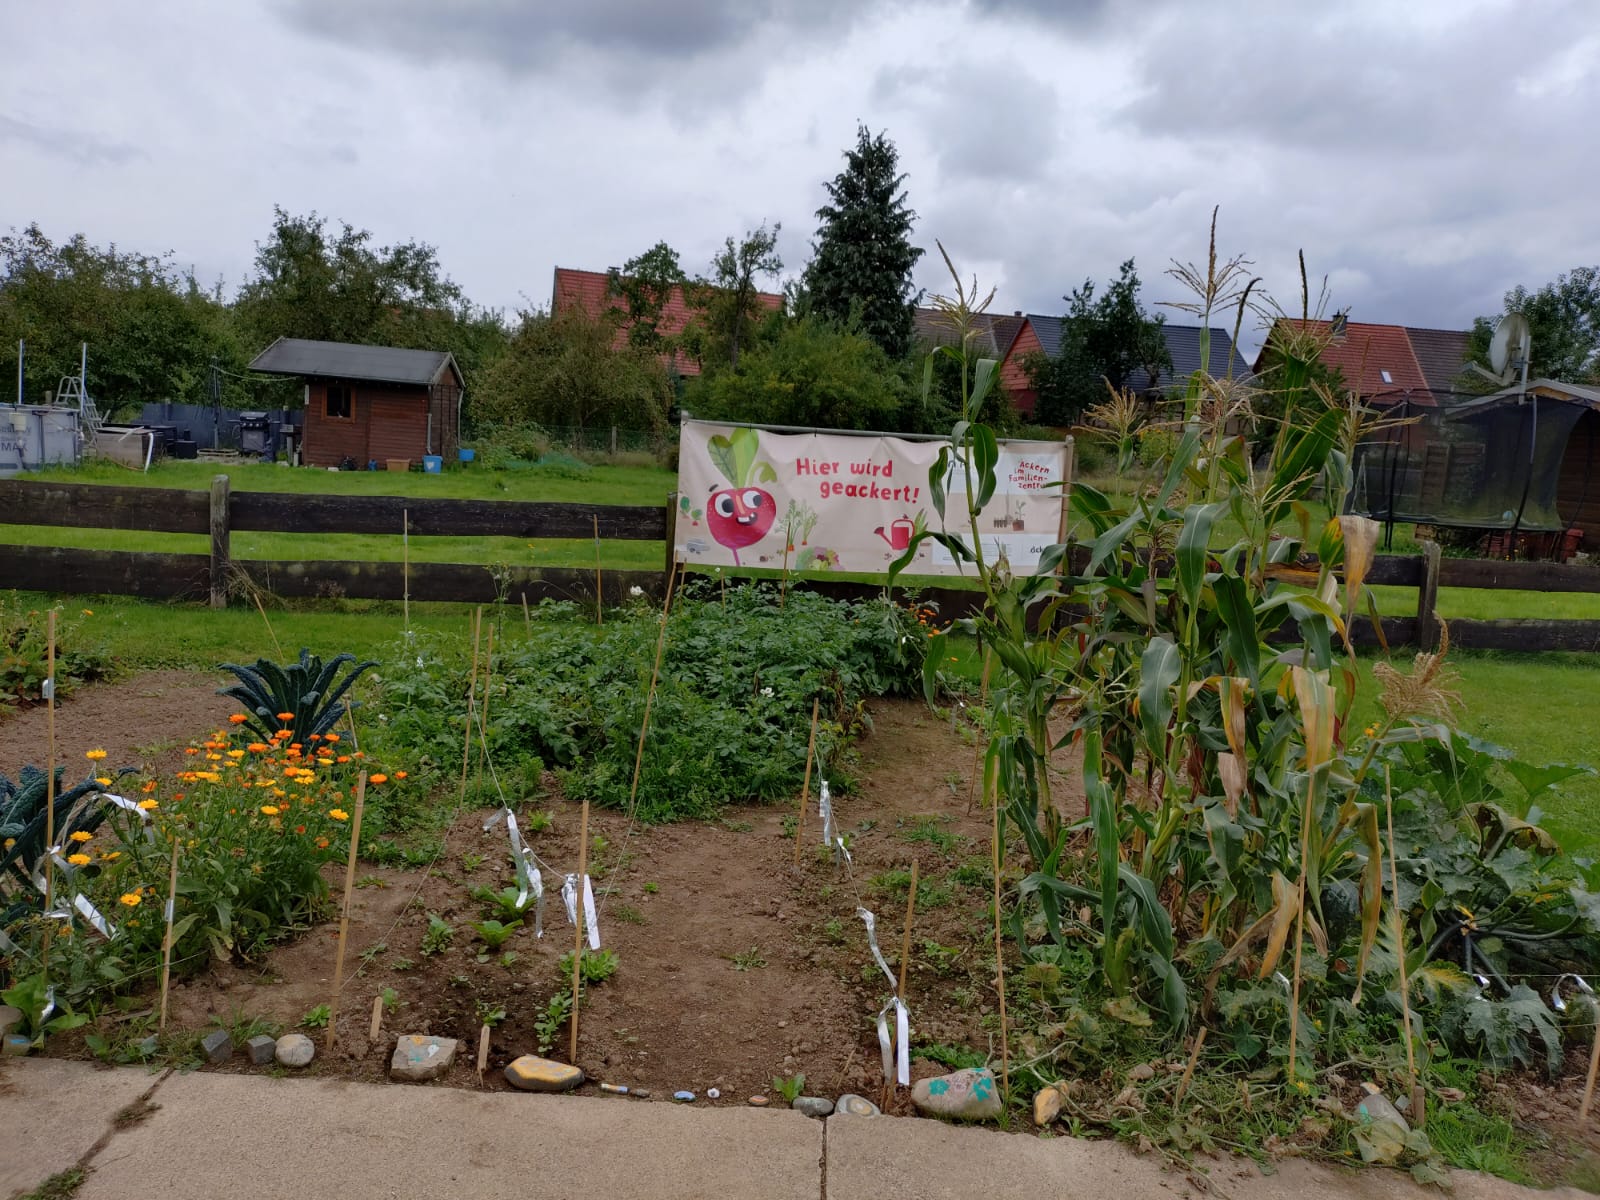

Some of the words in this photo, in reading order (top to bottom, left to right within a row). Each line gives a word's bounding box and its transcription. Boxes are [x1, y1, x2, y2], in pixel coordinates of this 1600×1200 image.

[796, 457, 839, 476] Hier
[850, 458, 893, 477] wird
[1019, 460, 1050, 474] Ackern
[820, 481, 920, 504] geackert!
